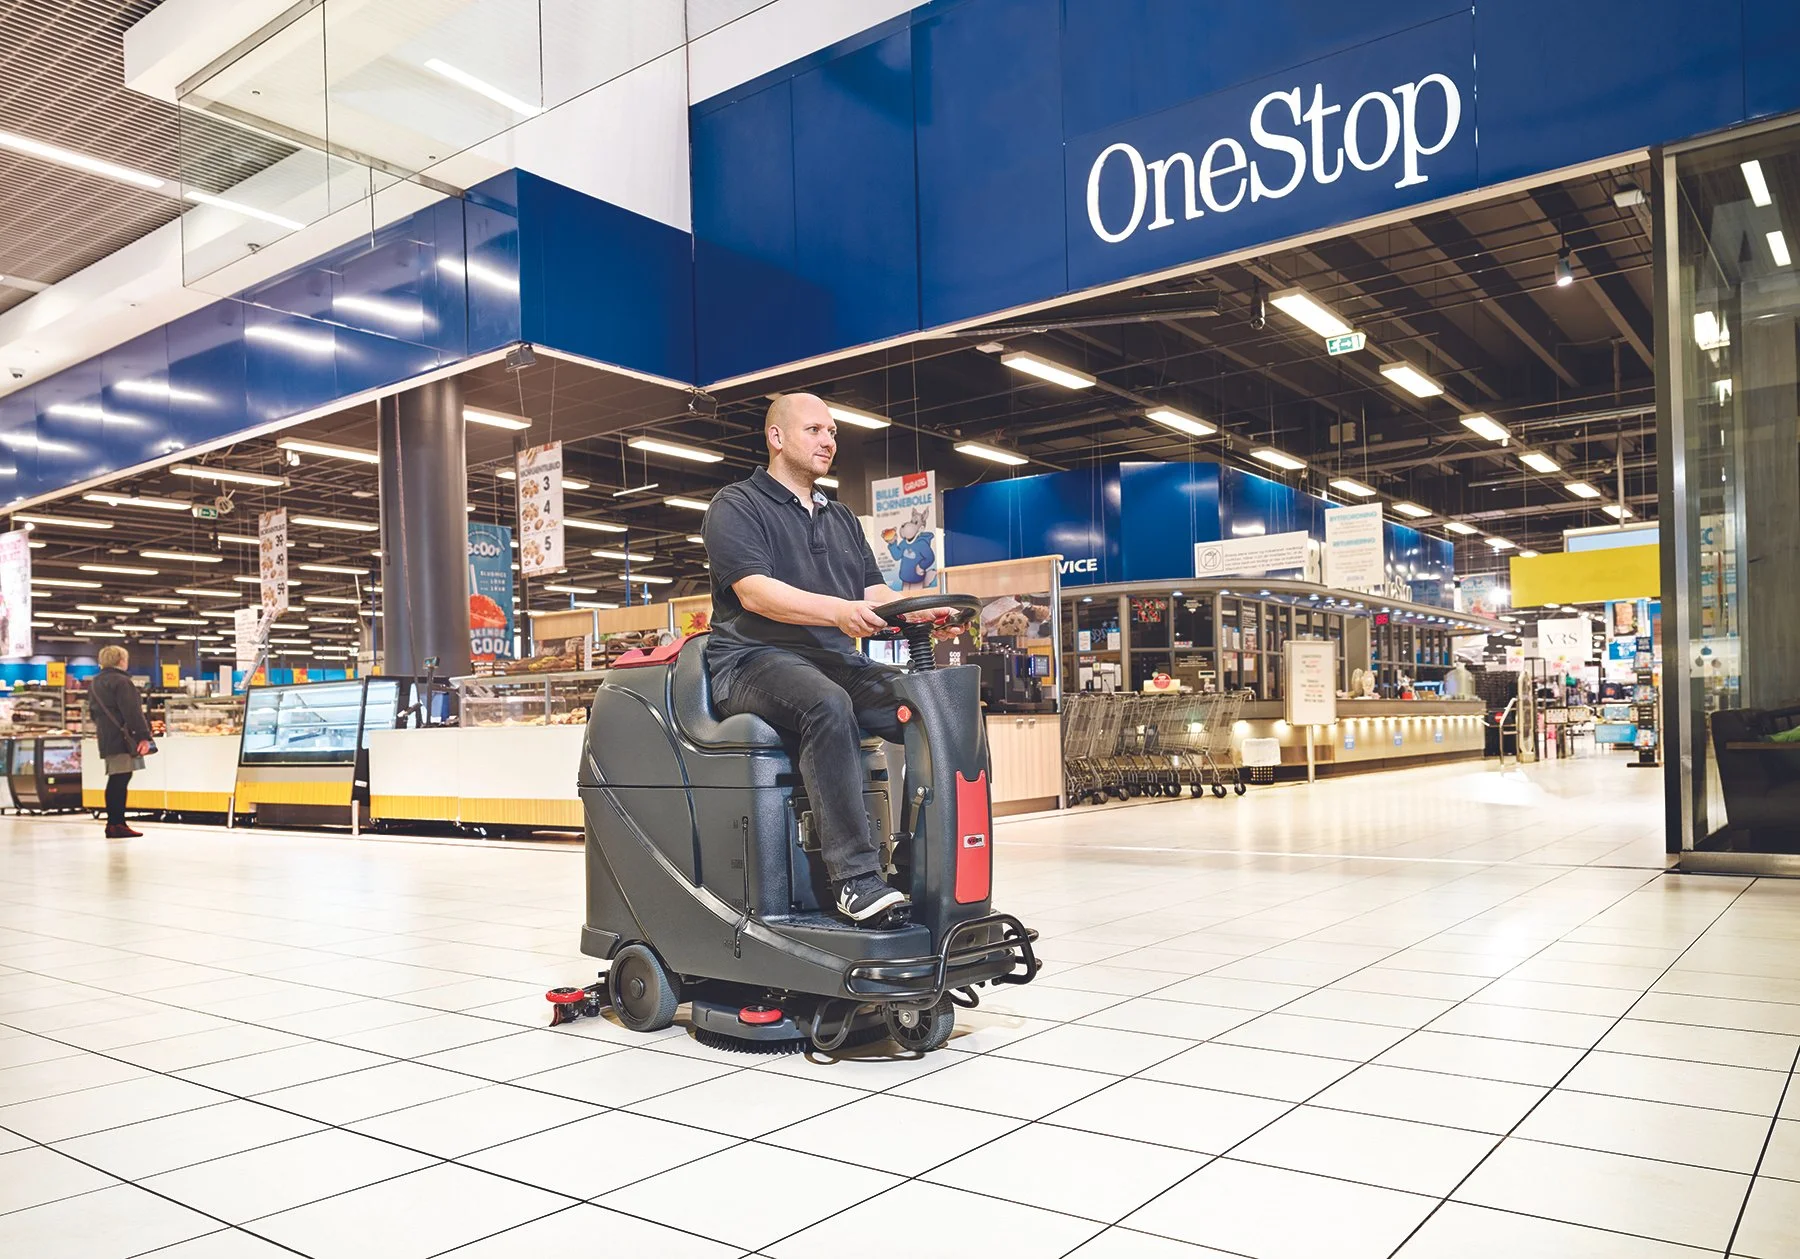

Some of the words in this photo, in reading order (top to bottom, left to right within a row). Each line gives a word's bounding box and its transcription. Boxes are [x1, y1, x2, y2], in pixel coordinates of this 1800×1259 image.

[1087, 73, 1461, 243] OneStop
[904, 478, 927, 492] GRATIS
[876, 488, 899, 500] BILLIE
[1058, 558, 1098, 574] VICE
[471, 638, 511, 657] COOL
